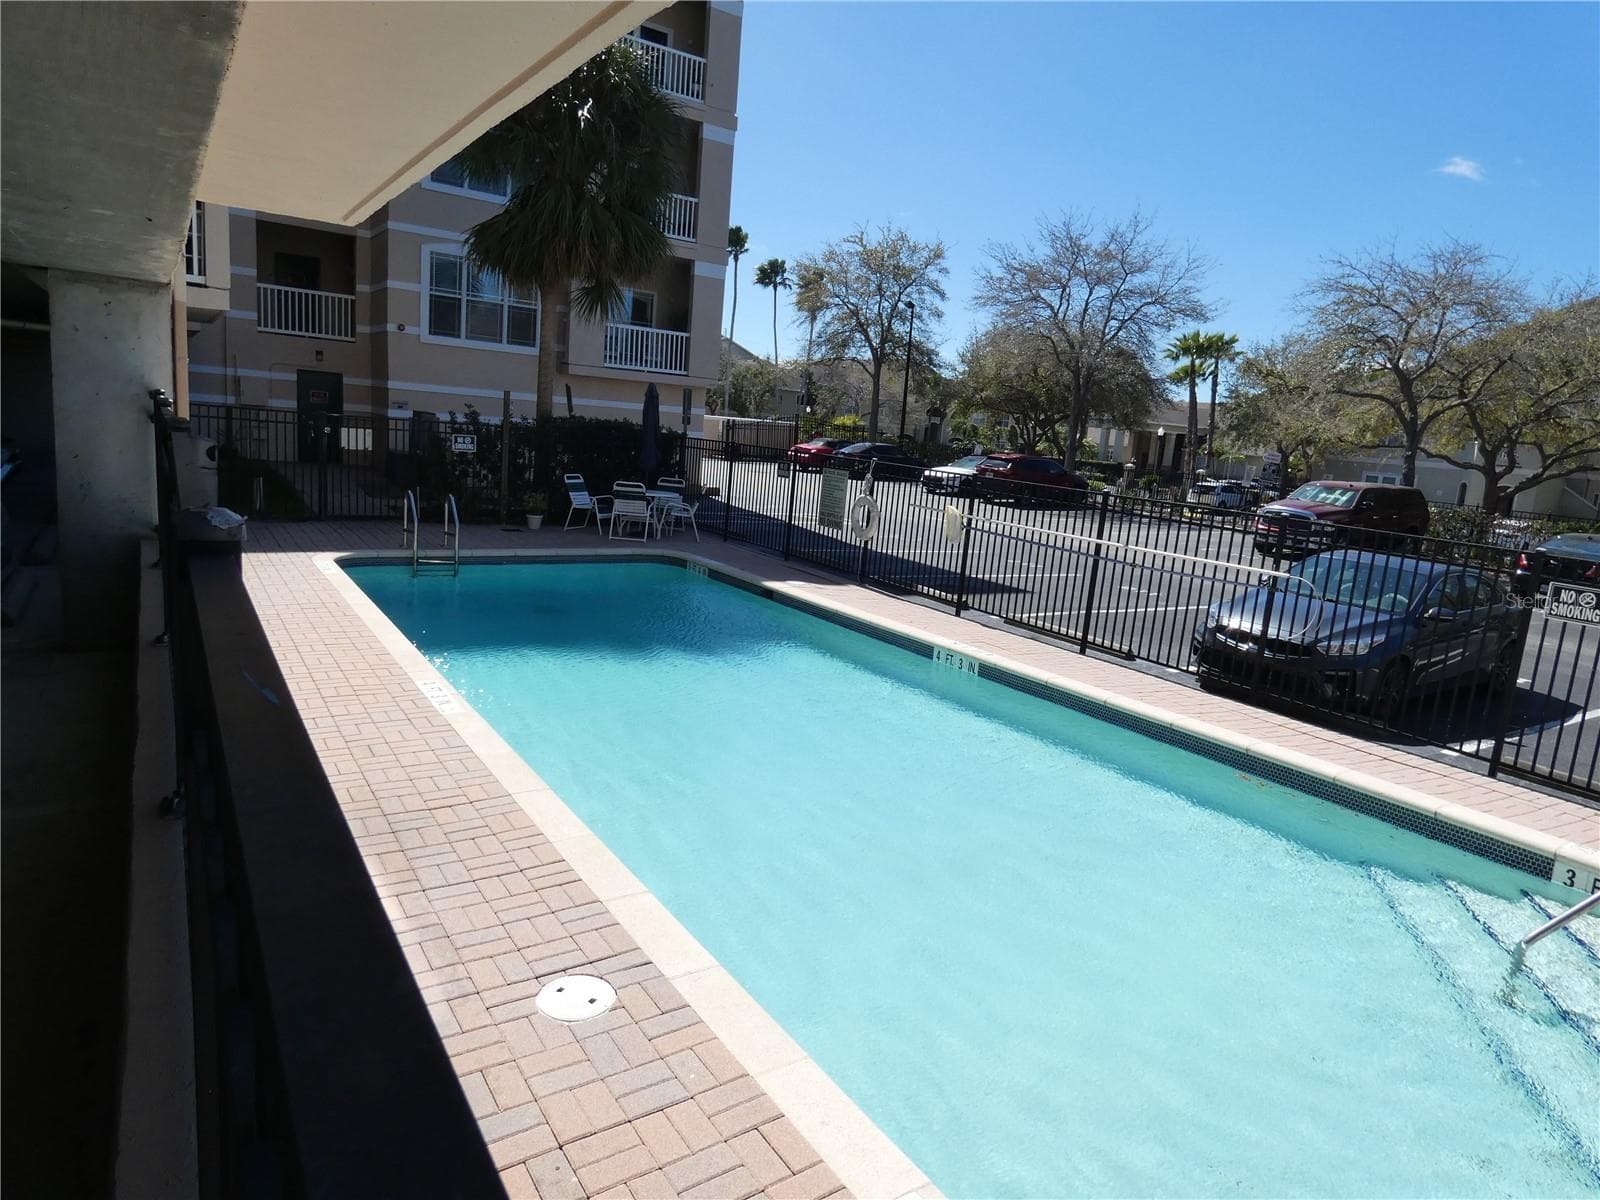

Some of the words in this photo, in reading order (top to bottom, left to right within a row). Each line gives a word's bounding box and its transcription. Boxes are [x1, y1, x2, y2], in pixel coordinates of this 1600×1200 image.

[1559, 589, 1577, 603] NO
[1551, 602, 1600, 622] SMOKING
[936, 650, 941, 662] 4
[958, 658, 963, 670] 3
[1563, 869, 1576, 888] 3
